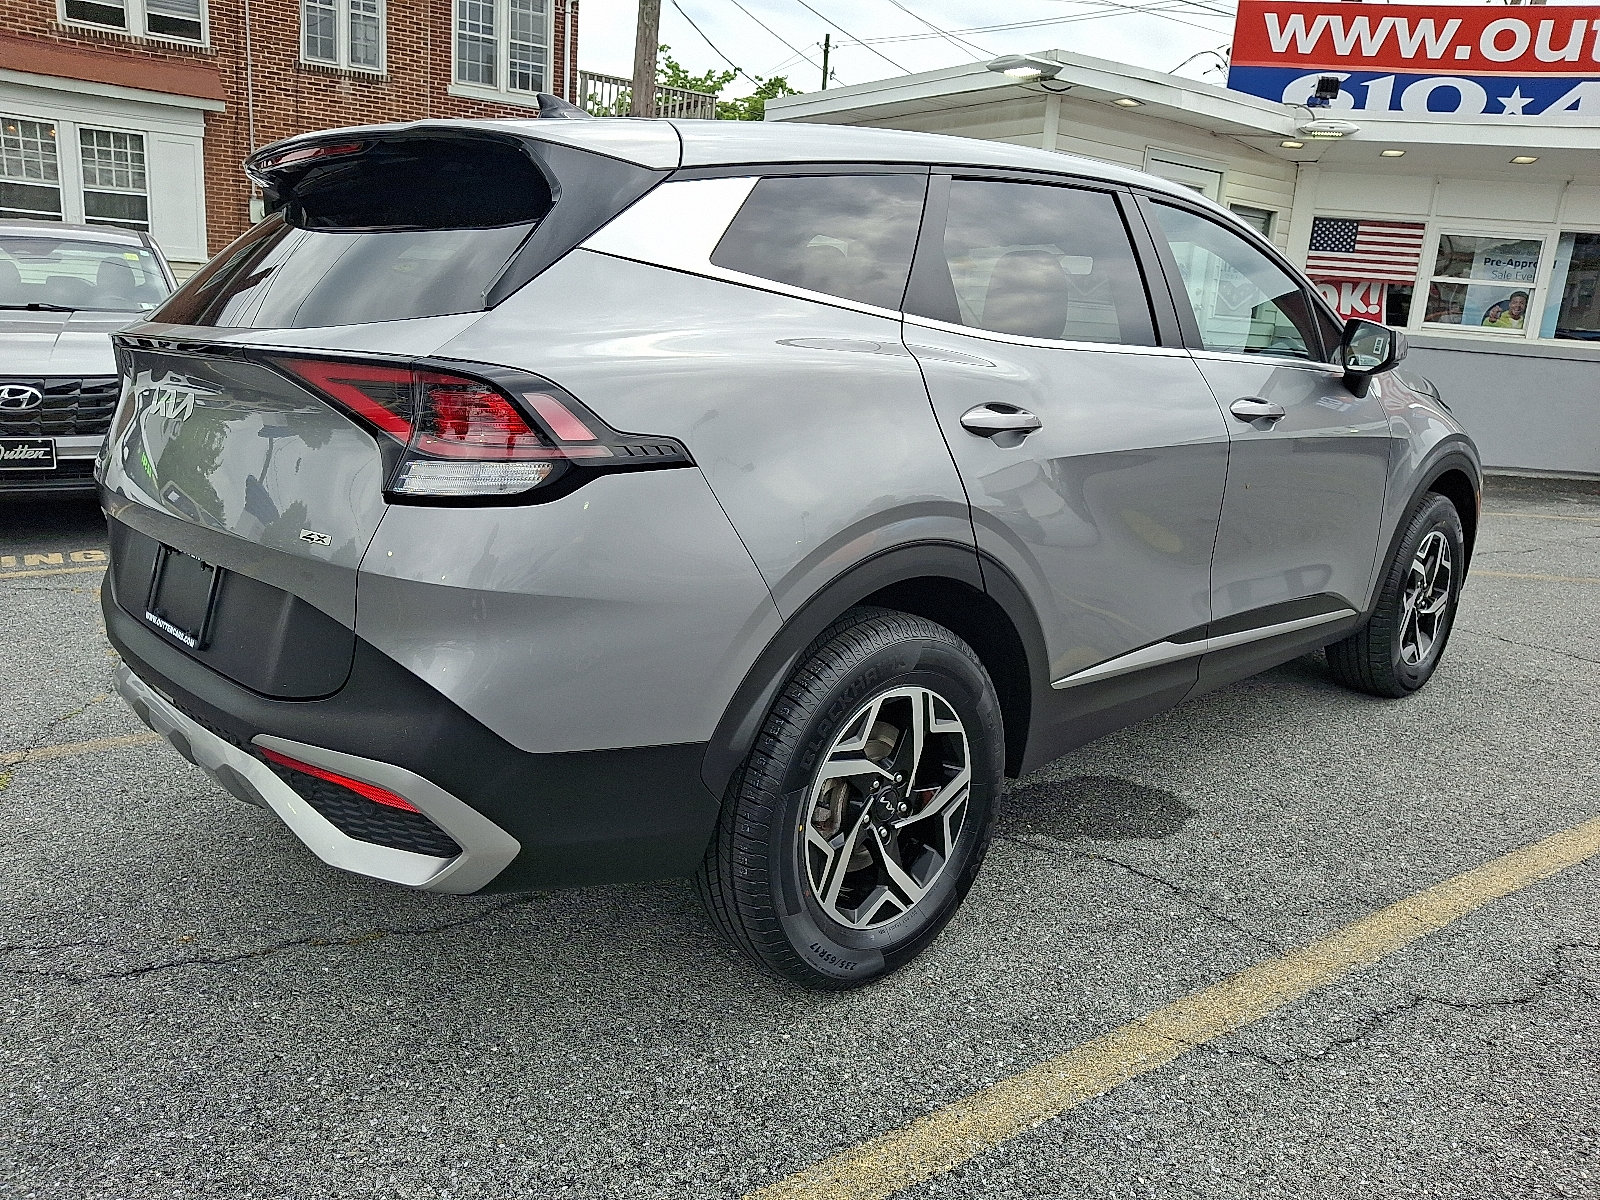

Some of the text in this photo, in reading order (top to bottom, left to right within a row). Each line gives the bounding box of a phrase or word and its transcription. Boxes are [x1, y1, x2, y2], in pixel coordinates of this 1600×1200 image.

[1264, 12, 1600, 62] www.ou
[1491, 270, 1534, 281] Sale Eve
[809, 942, 858, 971] 235/65R17
